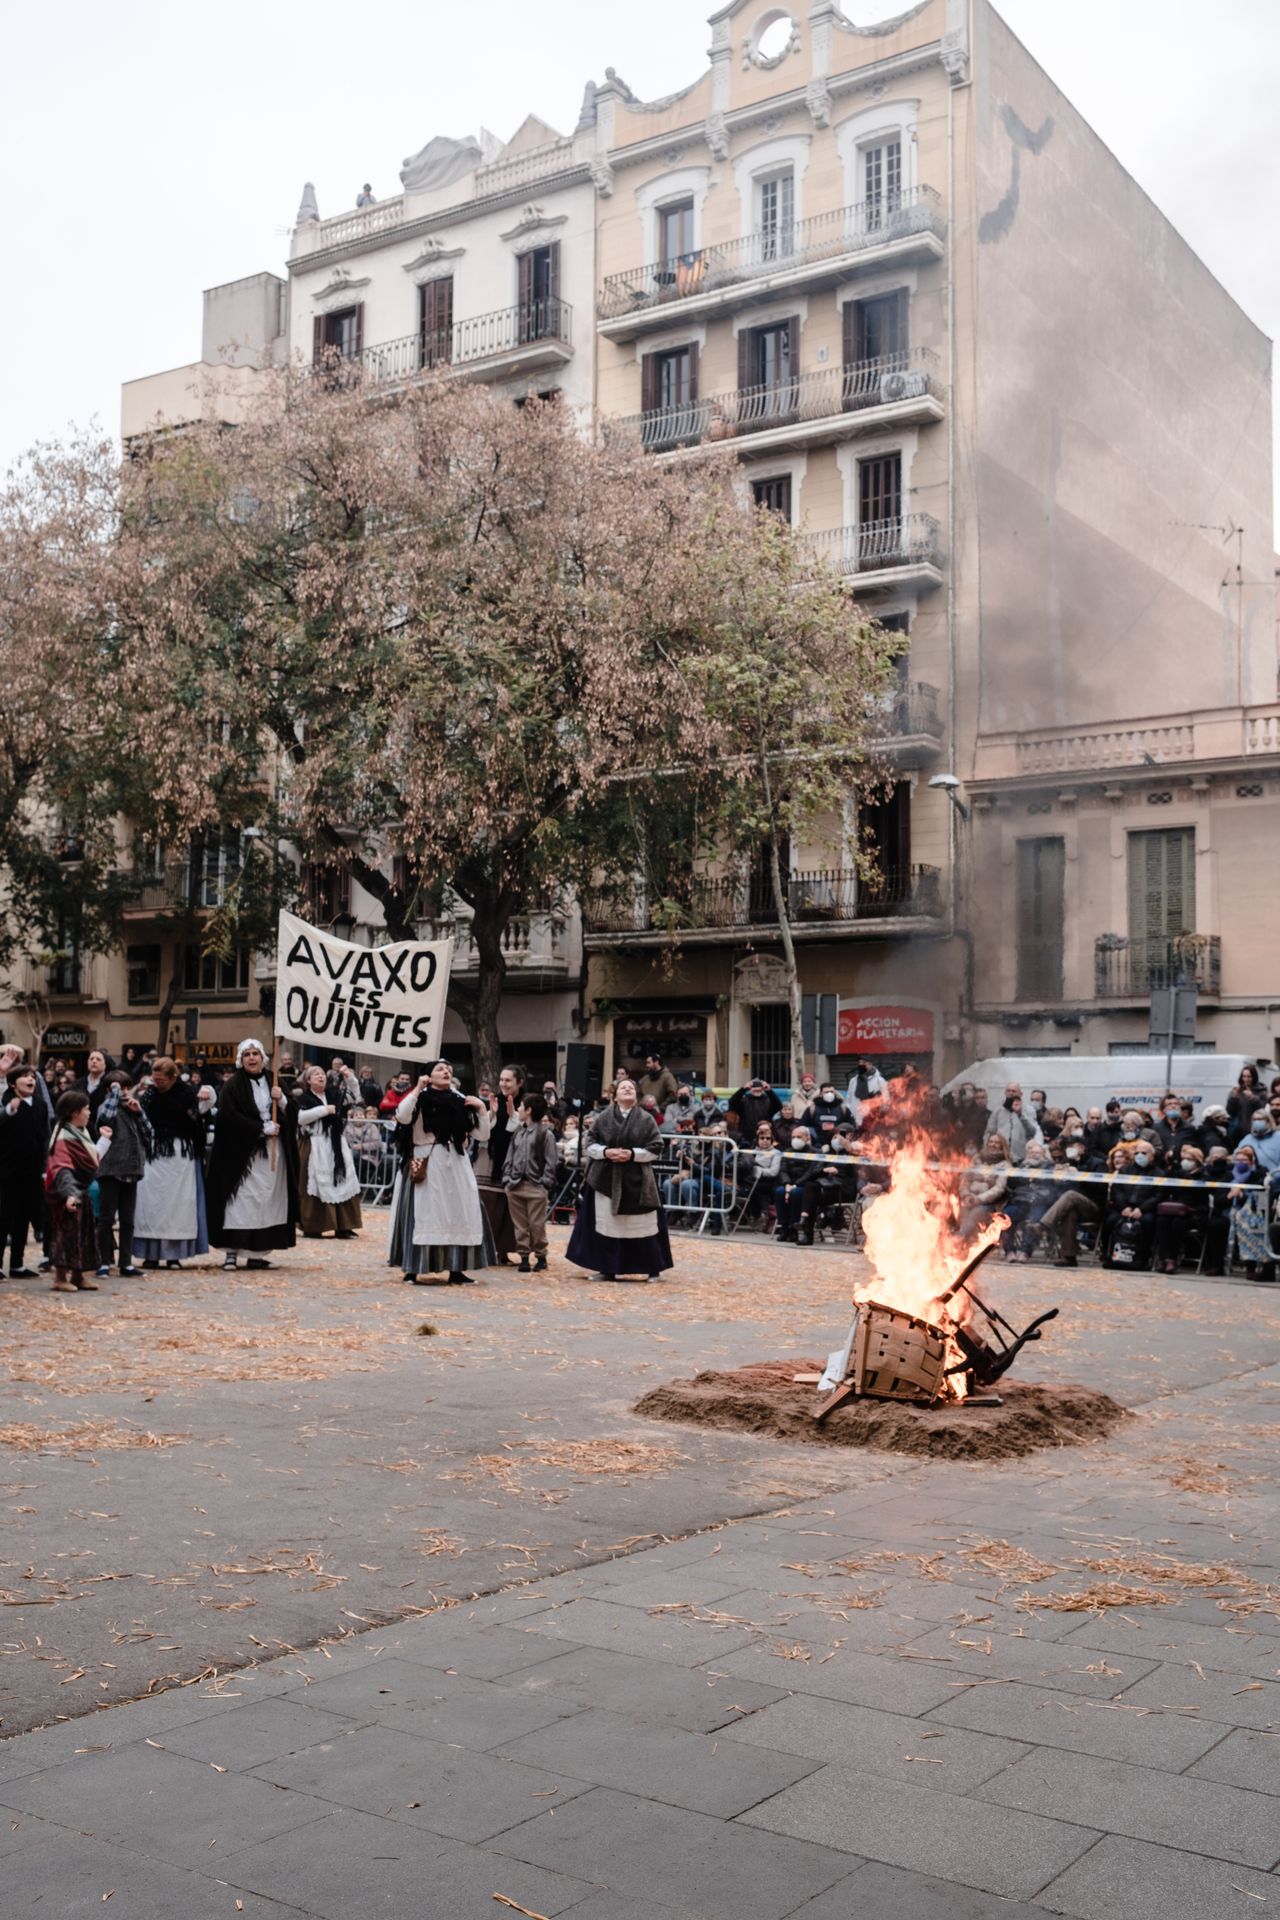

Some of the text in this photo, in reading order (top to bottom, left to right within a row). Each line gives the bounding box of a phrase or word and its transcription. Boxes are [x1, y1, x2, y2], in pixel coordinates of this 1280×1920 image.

[286, 934, 437, 993] AVAXO
[330, 983, 383, 1009] LES
[856, 1028, 925, 1039] PLANETARIA
